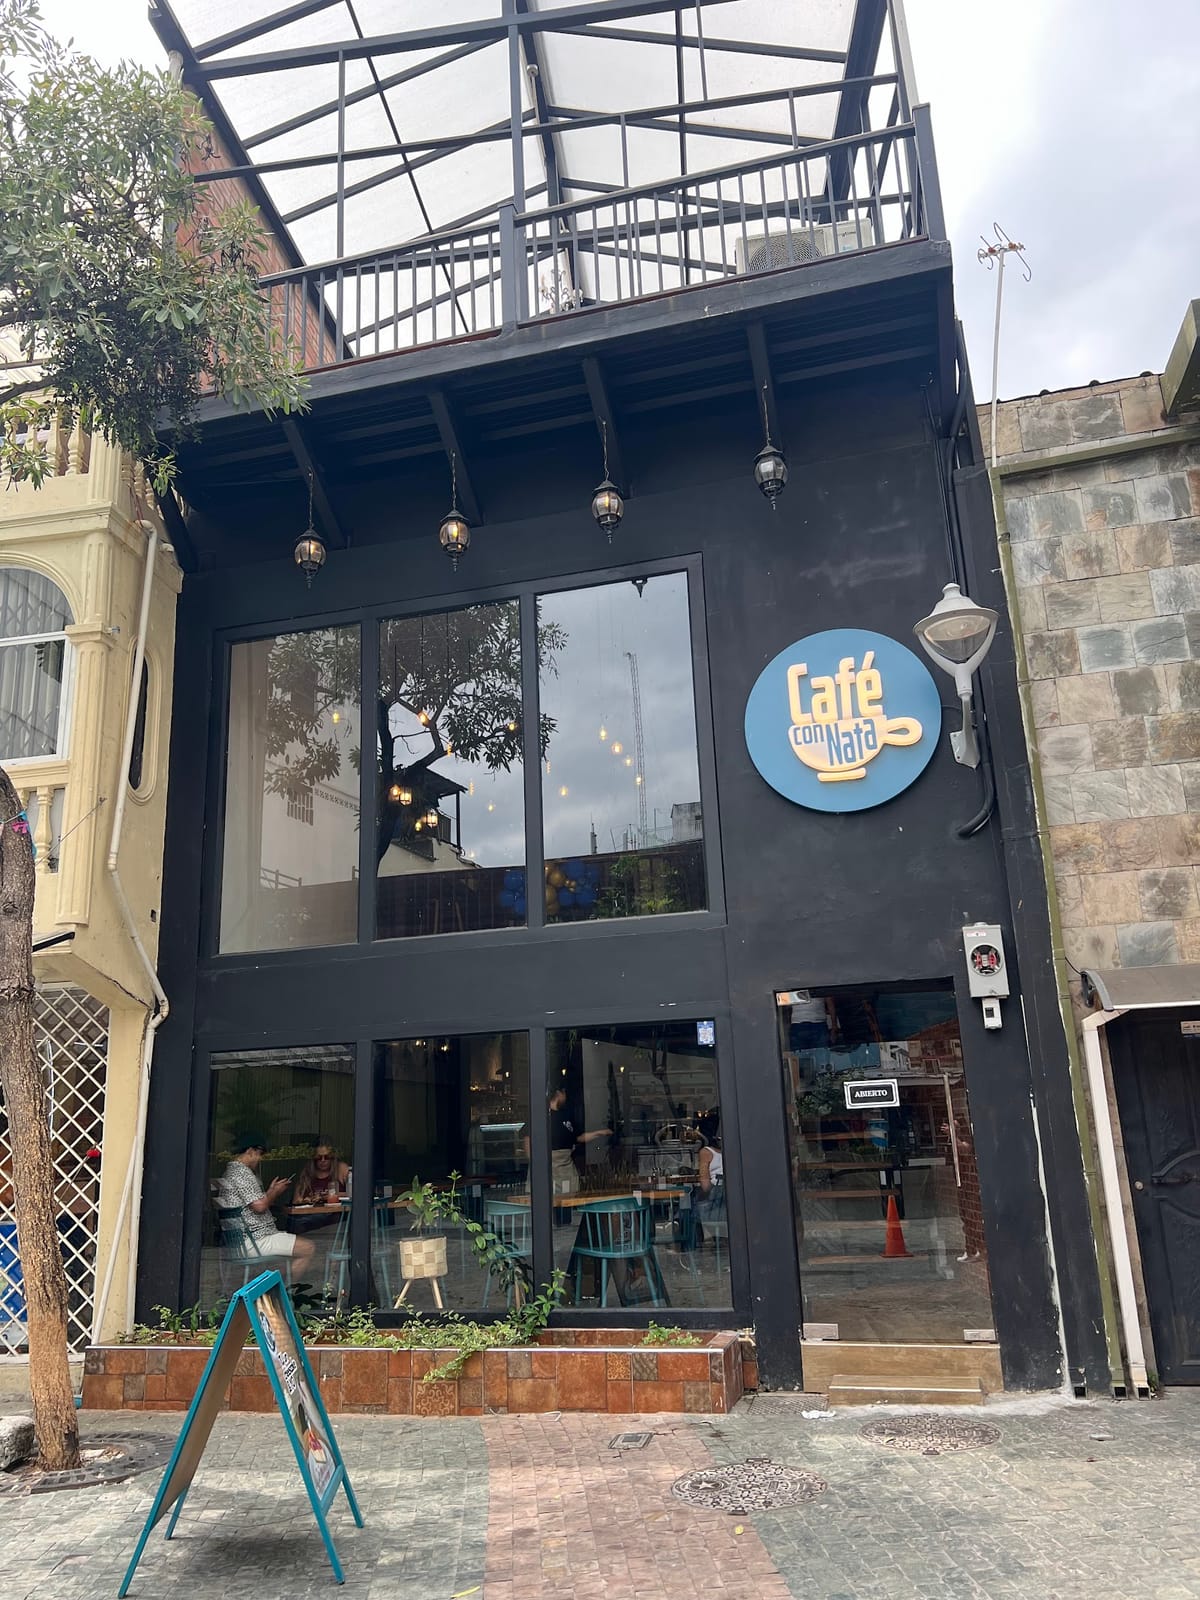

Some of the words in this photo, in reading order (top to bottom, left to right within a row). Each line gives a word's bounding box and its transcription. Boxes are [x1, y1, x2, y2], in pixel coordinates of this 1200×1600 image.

[787, 651, 883, 724] Café
[794, 724, 825, 745] con
[825, 718, 878, 766] Nata
[854, 1089, 888, 1098] ABIERTO
